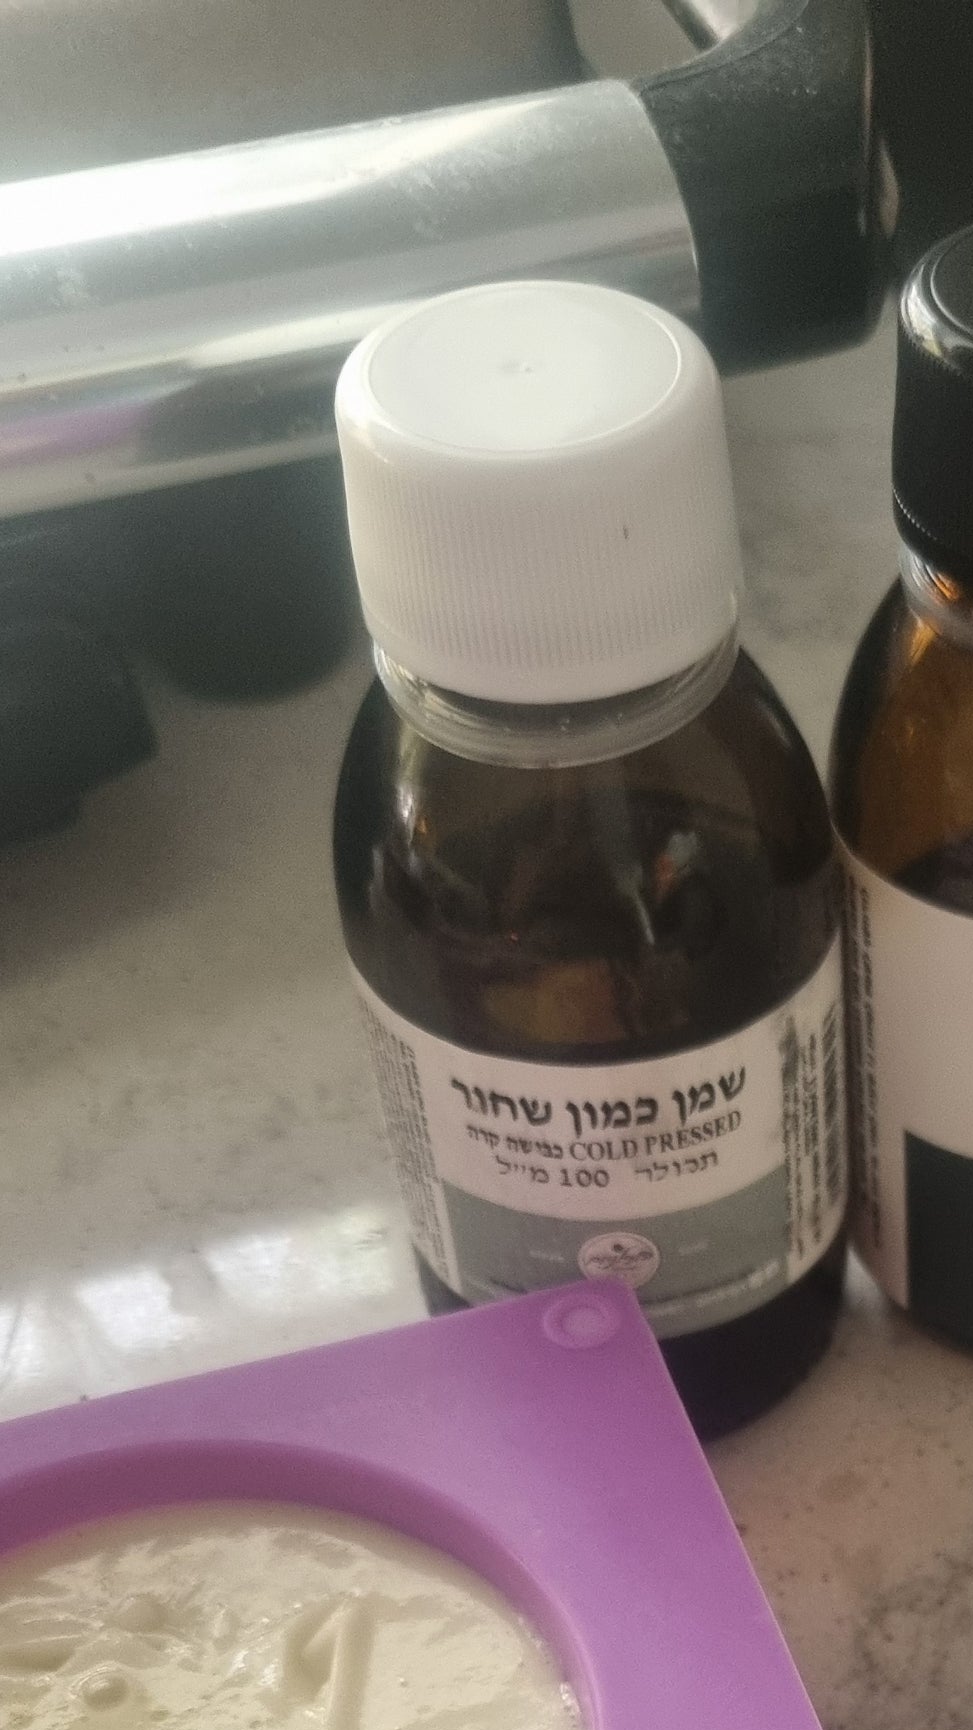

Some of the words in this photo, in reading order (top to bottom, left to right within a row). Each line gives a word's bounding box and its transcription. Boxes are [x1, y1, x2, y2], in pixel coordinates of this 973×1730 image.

[450, 1076, 552, 1127] שחור
[565, 1096, 660, 1139] כמון
[672, 1065, 746, 1127] שמן
[568, 1138, 638, 1162] COLD
[643, 1110, 743, 1155] PRESSED
[559, 1167, 611, 1188] 100
